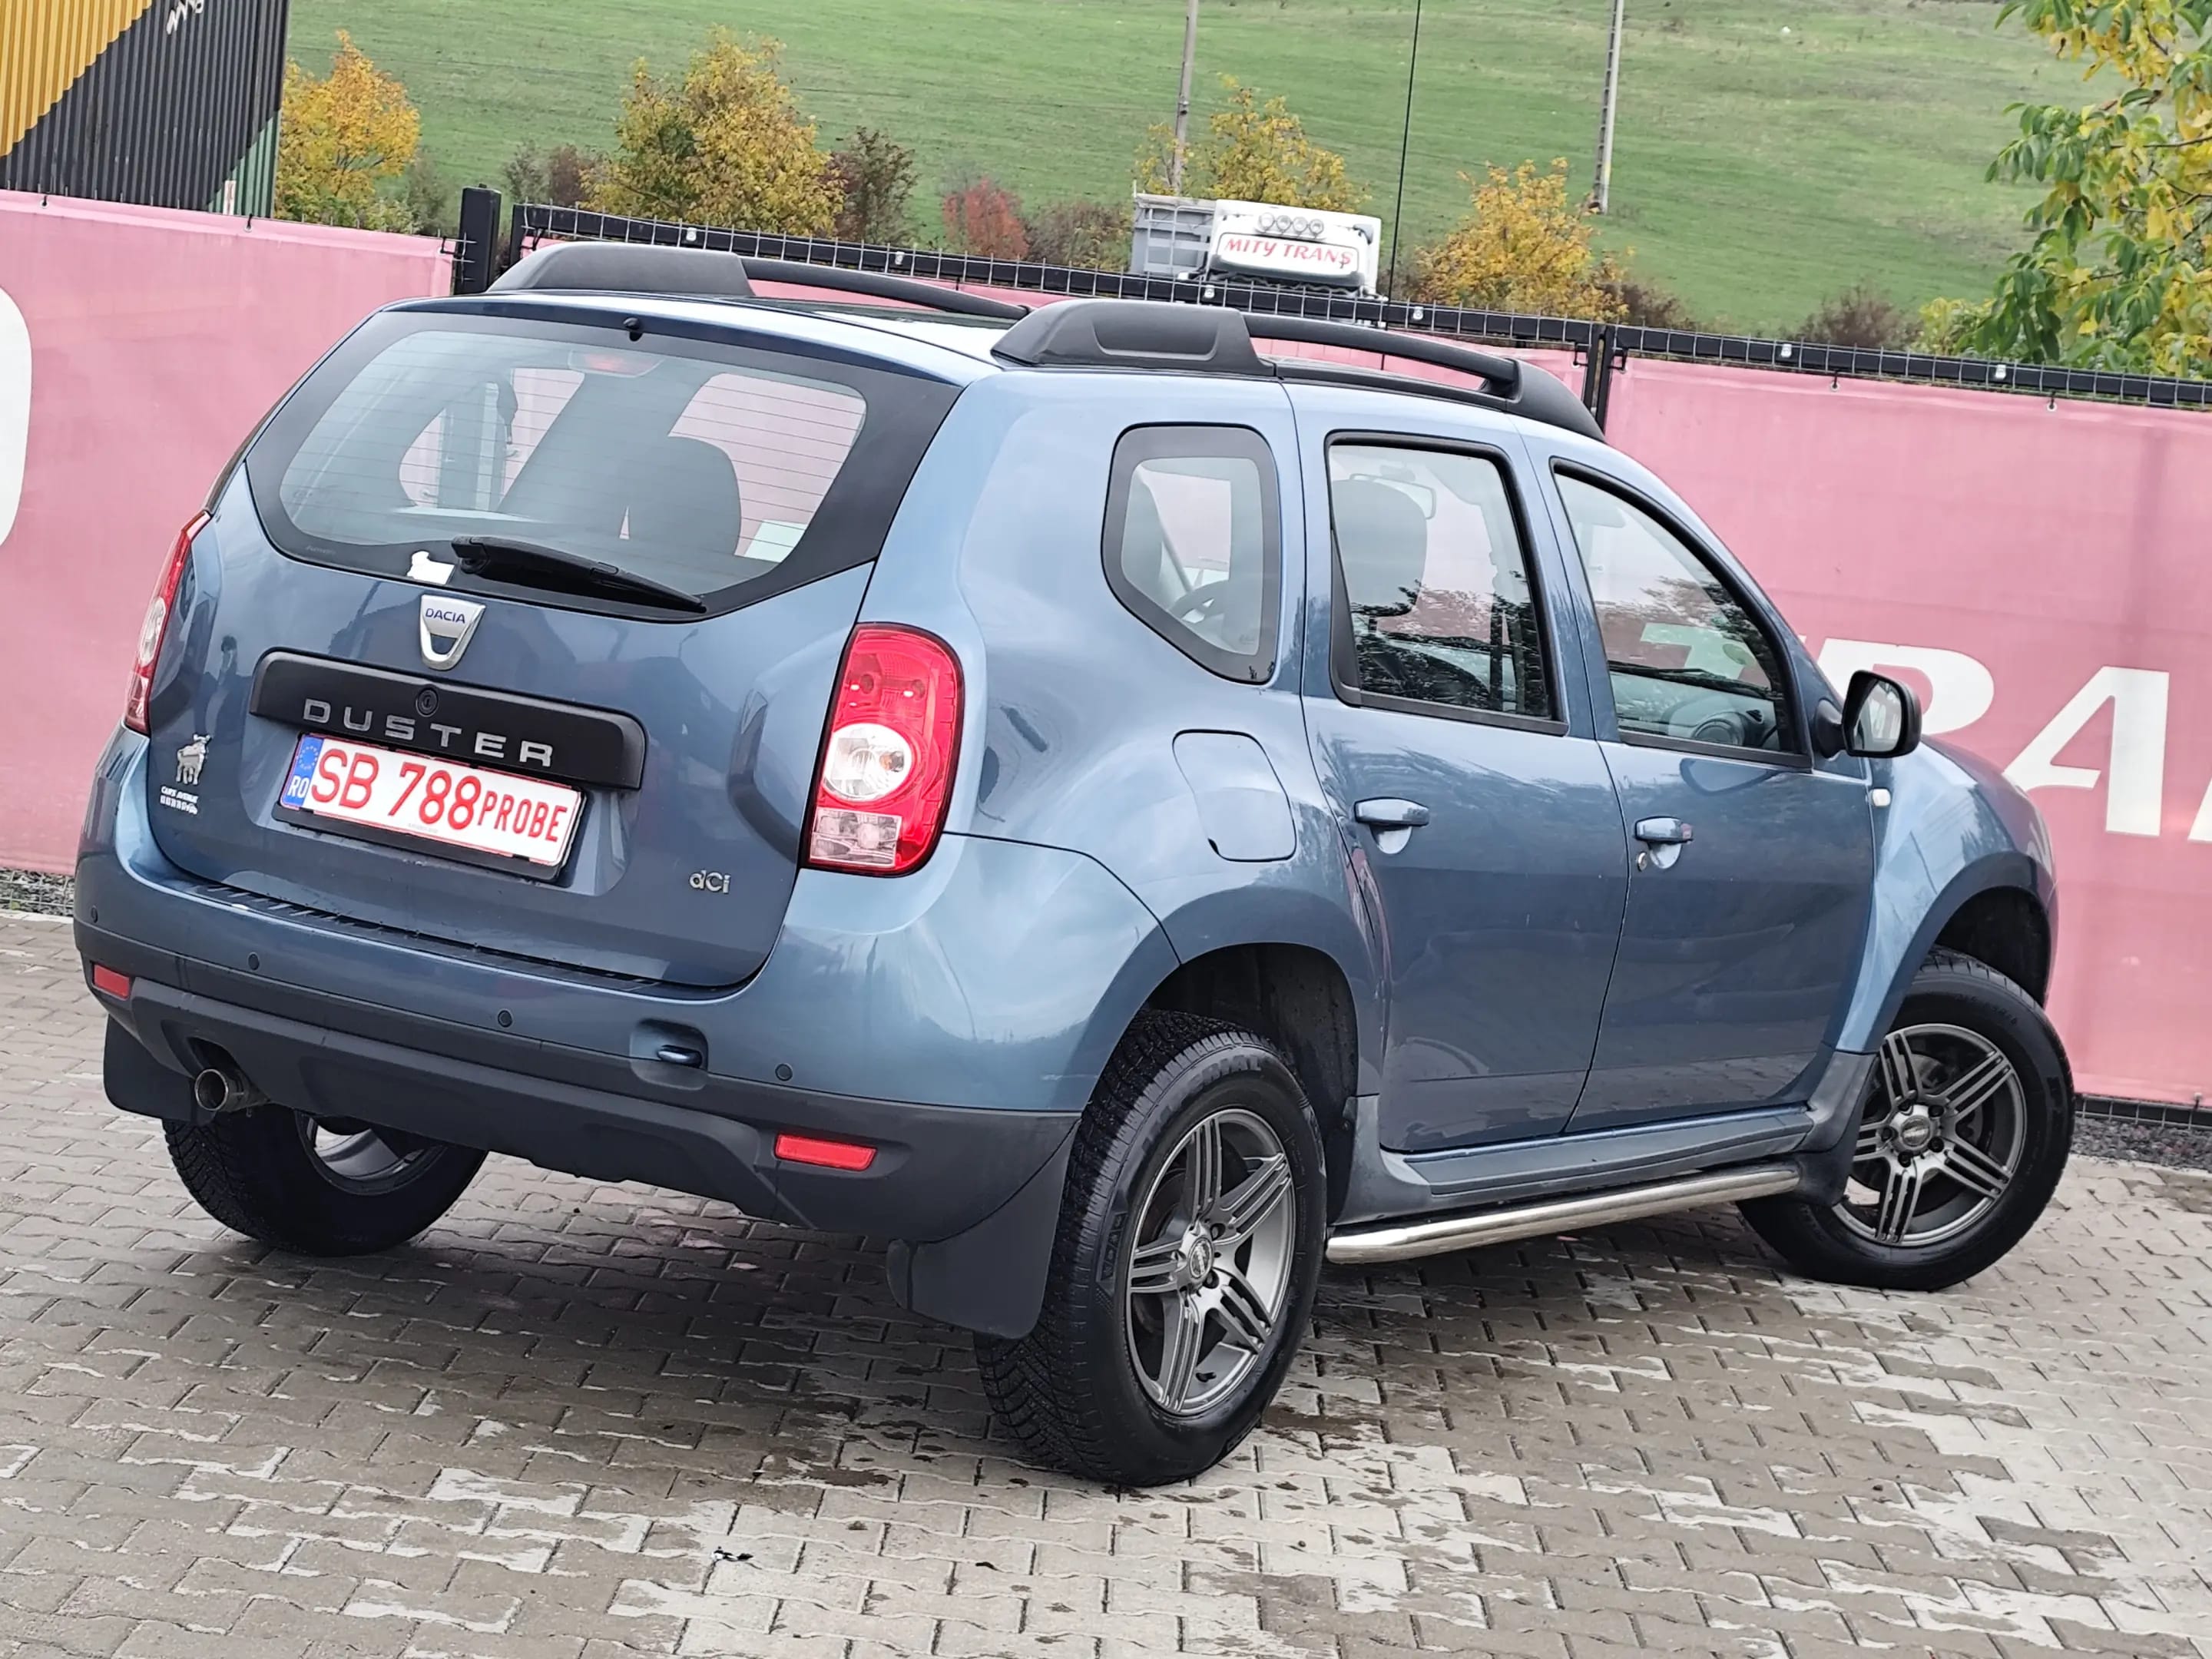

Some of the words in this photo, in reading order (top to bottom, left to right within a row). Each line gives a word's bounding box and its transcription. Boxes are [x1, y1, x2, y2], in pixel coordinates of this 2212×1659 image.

[1224, 238, 1277, 257] MITY
[425, 608, 465, 624] DACIA
[303, 698, 553, 767] DUSTER
[287, 775, 310, 799] RO
[311, 748, 379, 809] SB
